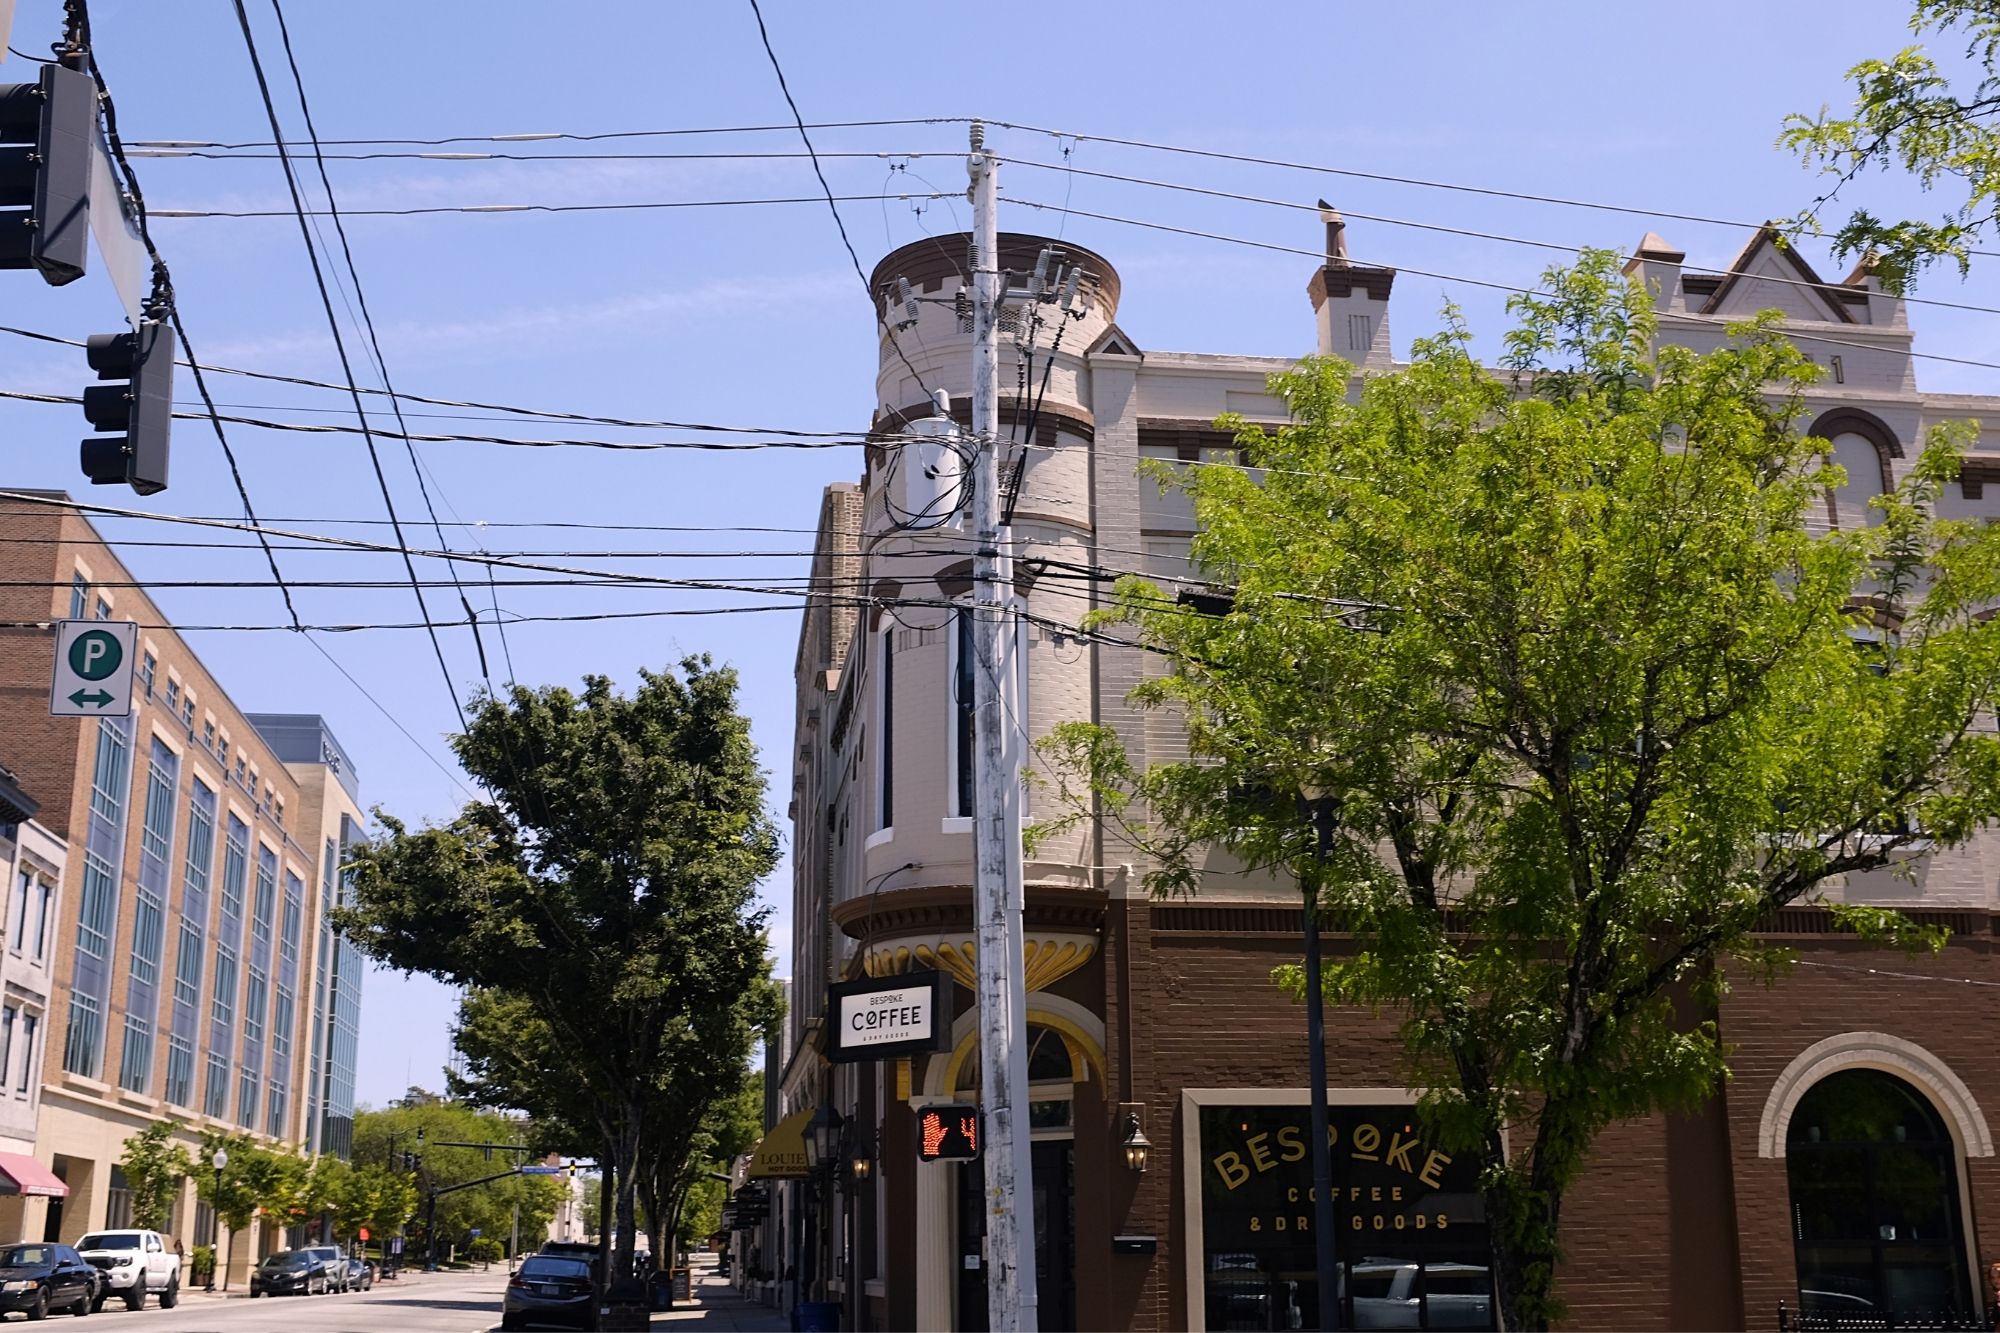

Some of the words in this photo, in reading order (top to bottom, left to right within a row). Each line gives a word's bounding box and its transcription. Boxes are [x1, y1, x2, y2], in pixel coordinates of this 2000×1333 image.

[83, 639, 107, 673] P
[960, 1117, 976, 1151] 4
[1249, 1216, 1262, 1232] &
[1275, 1216, 1309, 1231] DR
[1352, 1214, 1449, 1231] GOODS
